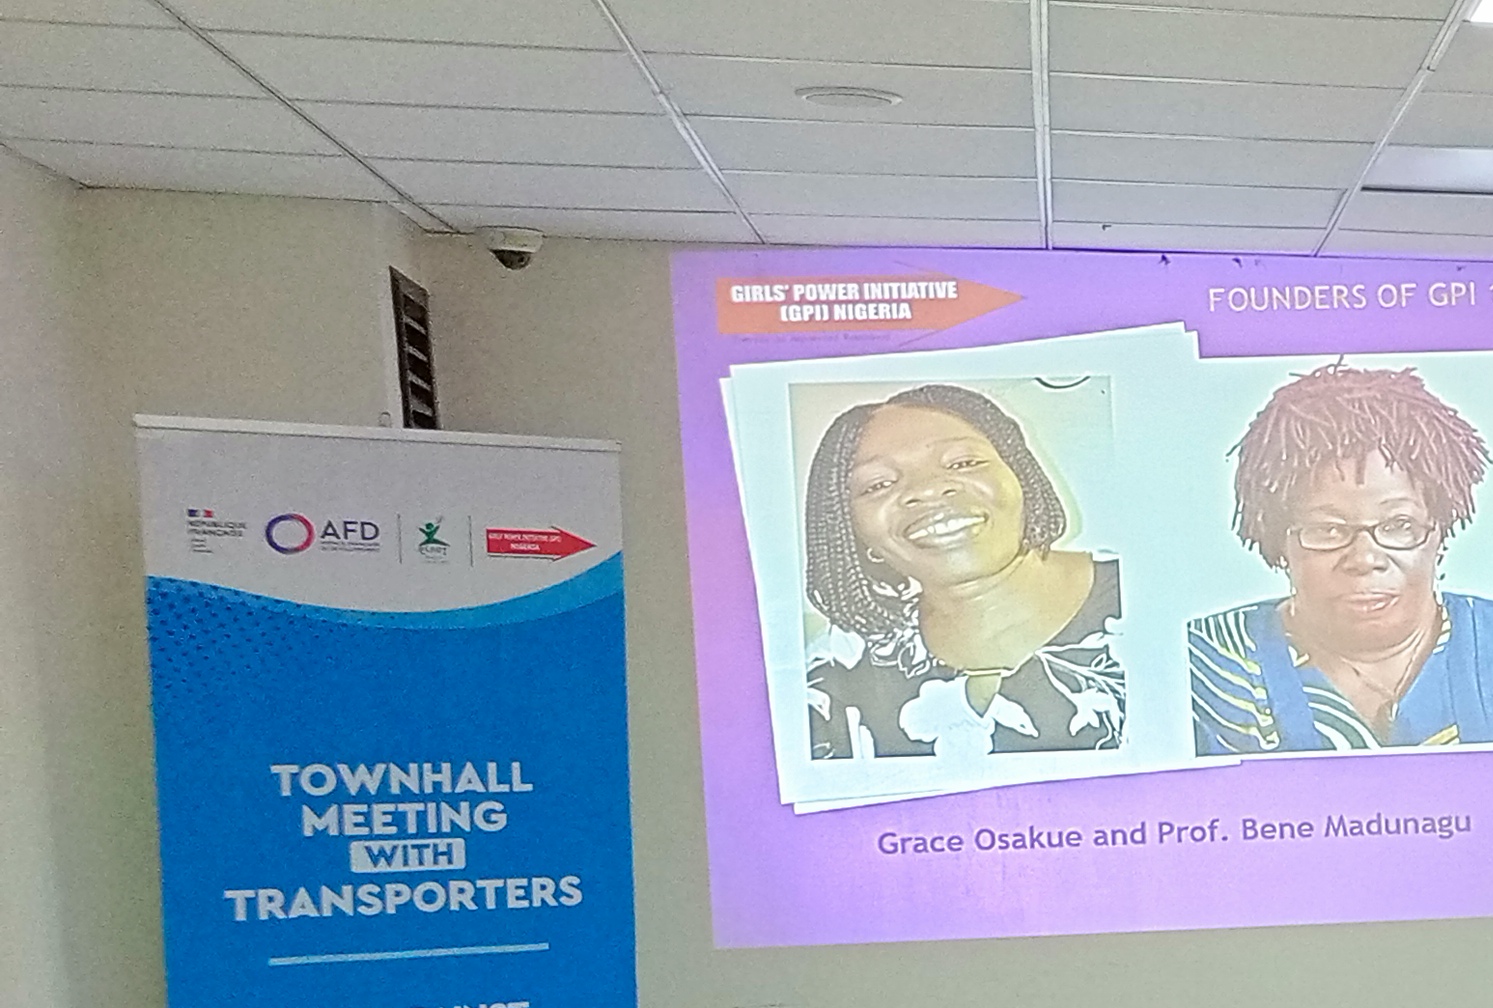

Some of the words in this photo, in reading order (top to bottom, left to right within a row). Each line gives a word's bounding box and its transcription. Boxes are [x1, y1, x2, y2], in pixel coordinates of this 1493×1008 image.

[730, 284, 790, 302] GIRLS'
[794, 283, 859, 301] POWER
[863, 281, 958, 300] INITIATIVE
[1208, 285, 1368, 312] FOUNDERS
[1377, 283, 1418, 308] OF
[1428, 281, 1476, 307] GPI
[780, 304, 829, 322] (GPI)
[833, 303, 912, 321] NIGERIA
[321, 520, 379, 540] AFD
[270, 761, 533, 797] TOWNHALL
[302, 801, 507, 837] MEETING
[877, 832, 964, 854] Grace
[975, 825, 1083, 850] Osakue
[1093, 821, 1146, 846] and
[1158, 819, 1229, 844] Prof.
[1242, 818, 1314, 841] Bene
[1325, 812, 1471, 839] Madunagu
[364, 842, 454, 868] WITH
[224, 876, 583, 921] TRANSPORTERS
